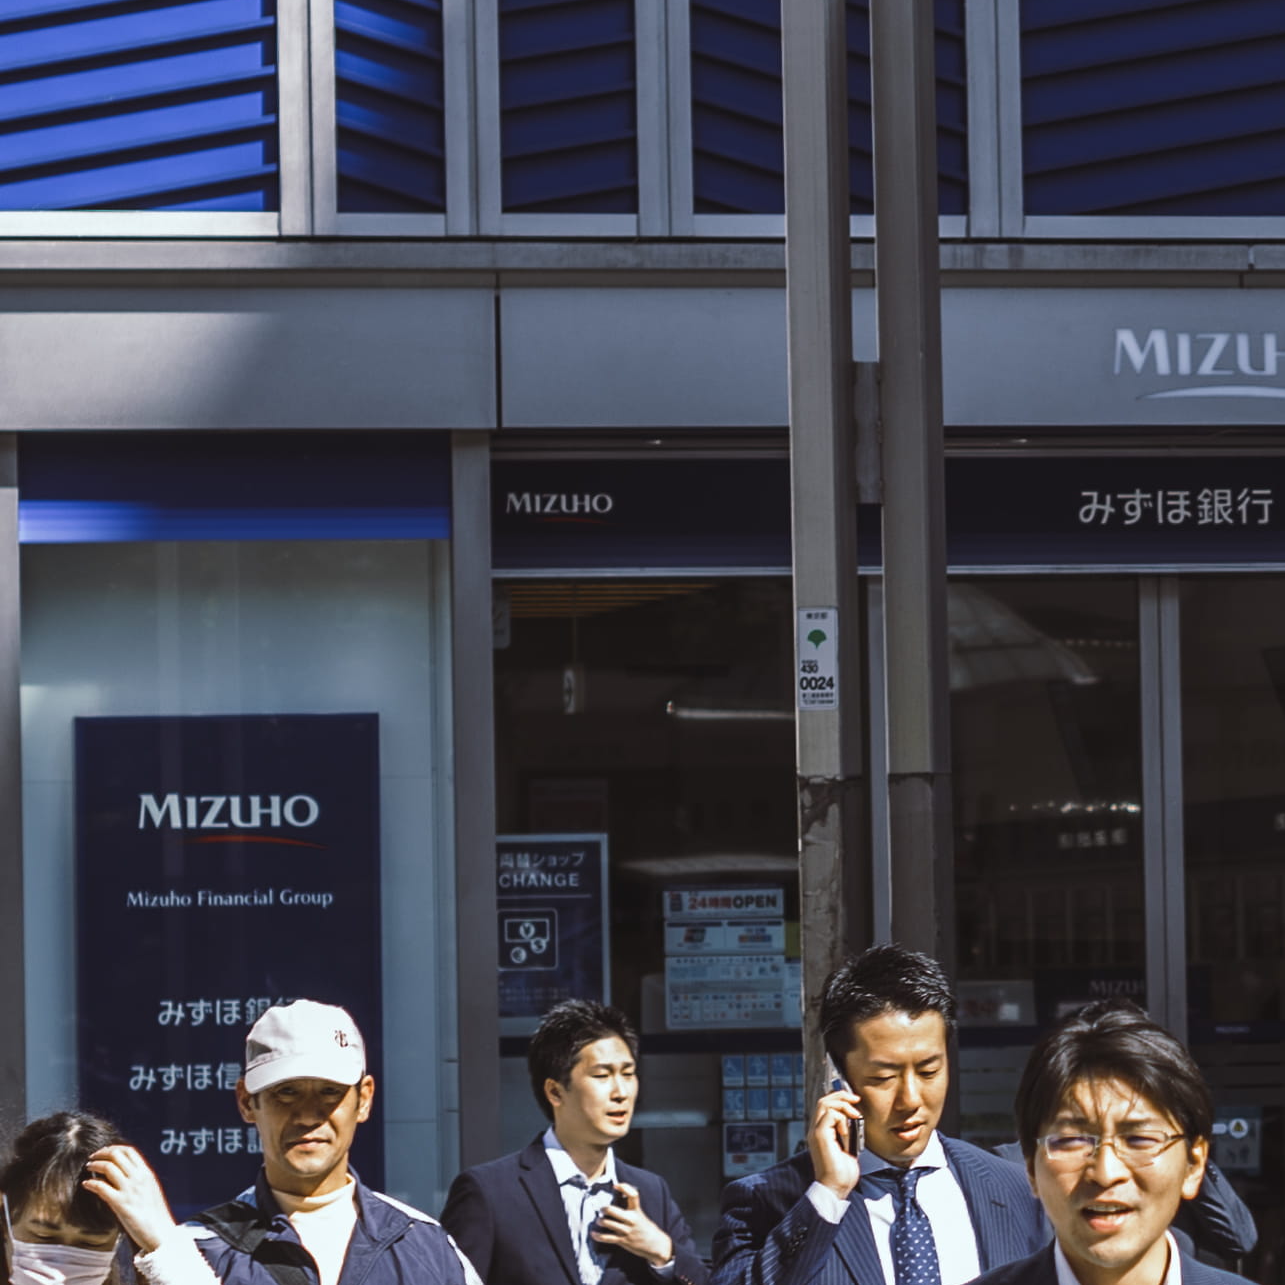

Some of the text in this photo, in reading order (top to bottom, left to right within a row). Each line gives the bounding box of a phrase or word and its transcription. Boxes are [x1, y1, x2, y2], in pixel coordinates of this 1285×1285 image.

[505, 492, 613, 514] MIZUHO
[1079, 488, 1273, 525] みずほ銀行
[800, 676, 834, 691] 0024
[138, 793, 319, 829] MIZUHO
[499, 873, 580, 888] CHANGE
[127, 888, 333, 908] Mizuho Financial Group
[158, 997, 294, 1026] みずほ銀
